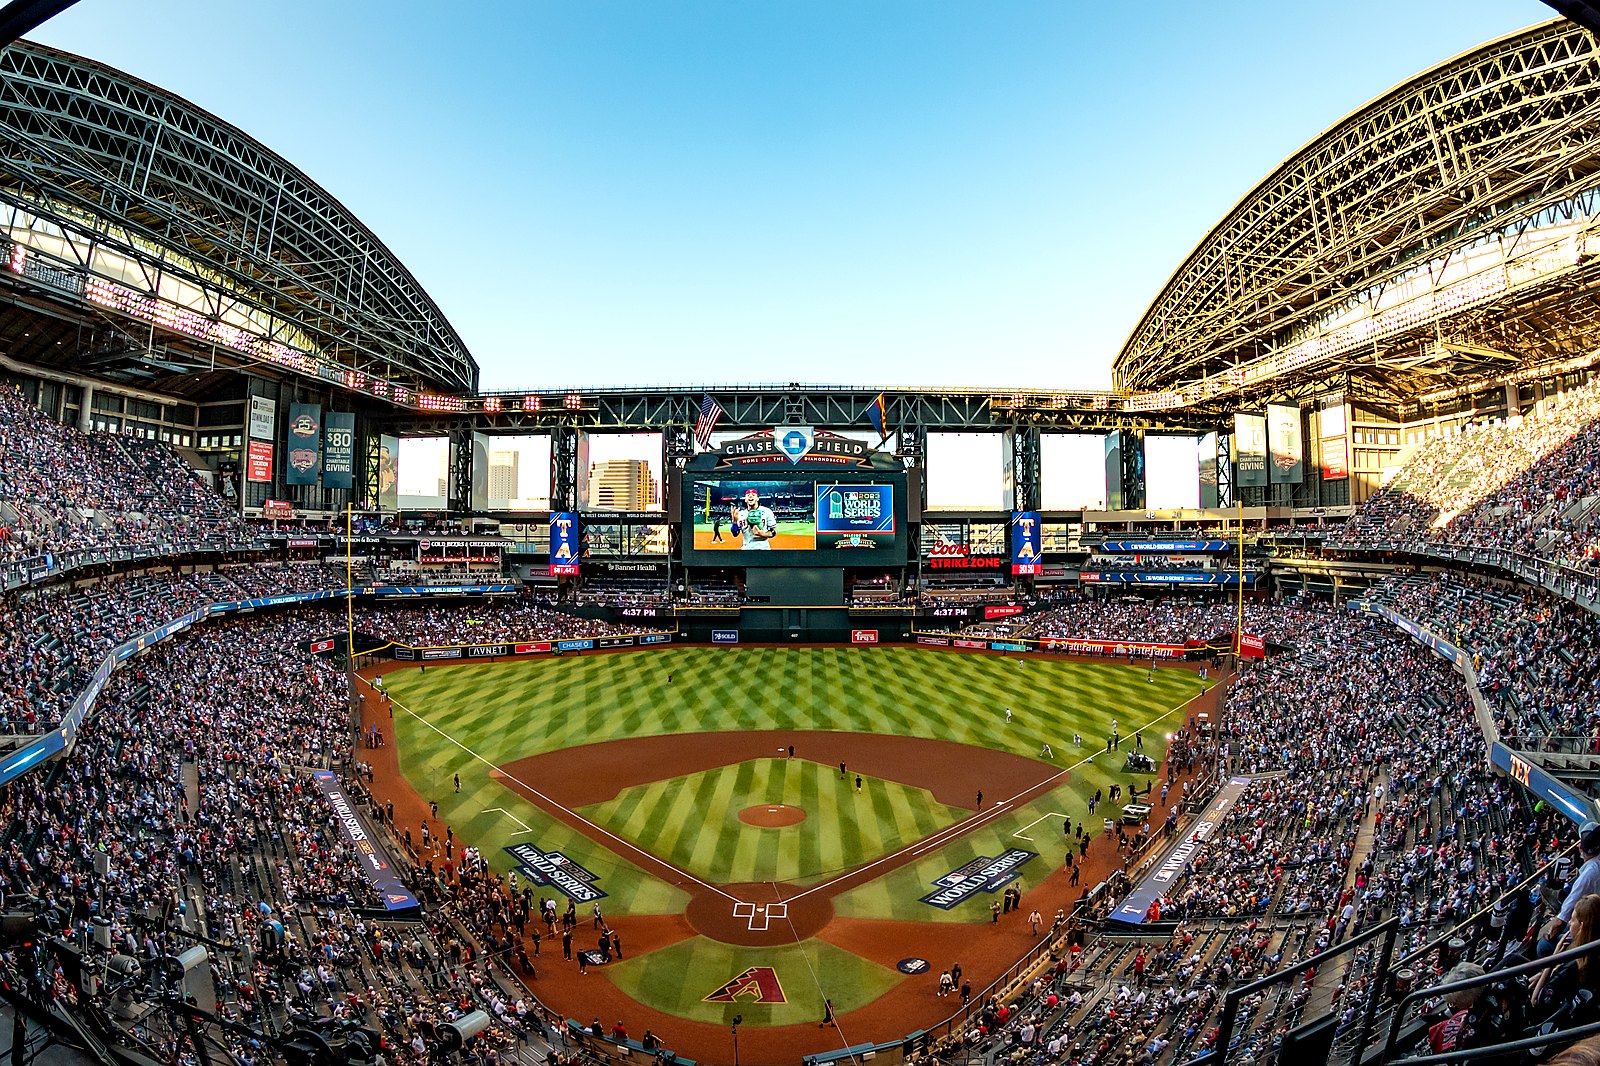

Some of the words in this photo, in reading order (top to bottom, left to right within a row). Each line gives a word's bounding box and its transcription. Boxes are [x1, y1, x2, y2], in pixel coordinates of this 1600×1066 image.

[299, 420, 310, 429] 25
[328, 433, 351, 447] $80
[726, 442, 772, 455] CHASE
[816, 441, 863, 454] FIELD
[326, 464, 350, 472] GIVING
[1240, 462, 1264, 471] GIVING
[844, 500, 880, 508] WORLD
[844, 508, 880, 517] SERIES
[557, 520, 571, 537] T
[1019, 519, 1034, 536] T
[555, 542, 572, 558] A
[931, 540, 971, 555] Coors
[971, 544, 1004, 554] LIGHT
[1018, 542, 1034, 558] A
[930, 558, 968, 568] STRIKE
[970, 558, 1000, 568] ZONE
[1510, 754, 1532, 787] TEX
[331, 798, 352, 821] WORLD
[344, 818, 368, 840] SERIES
[1163, 844, 1195, 871] WORLD
[513, 845, 557, 873] WORLD
[547, 871, 597, 900] SERIES
[960, 858, 991, 875] 2023
[929, 876, 988, 905] WORLD
[981, 851, 1029, 877] SERIES
[1121, 905, 1143, 915] T
